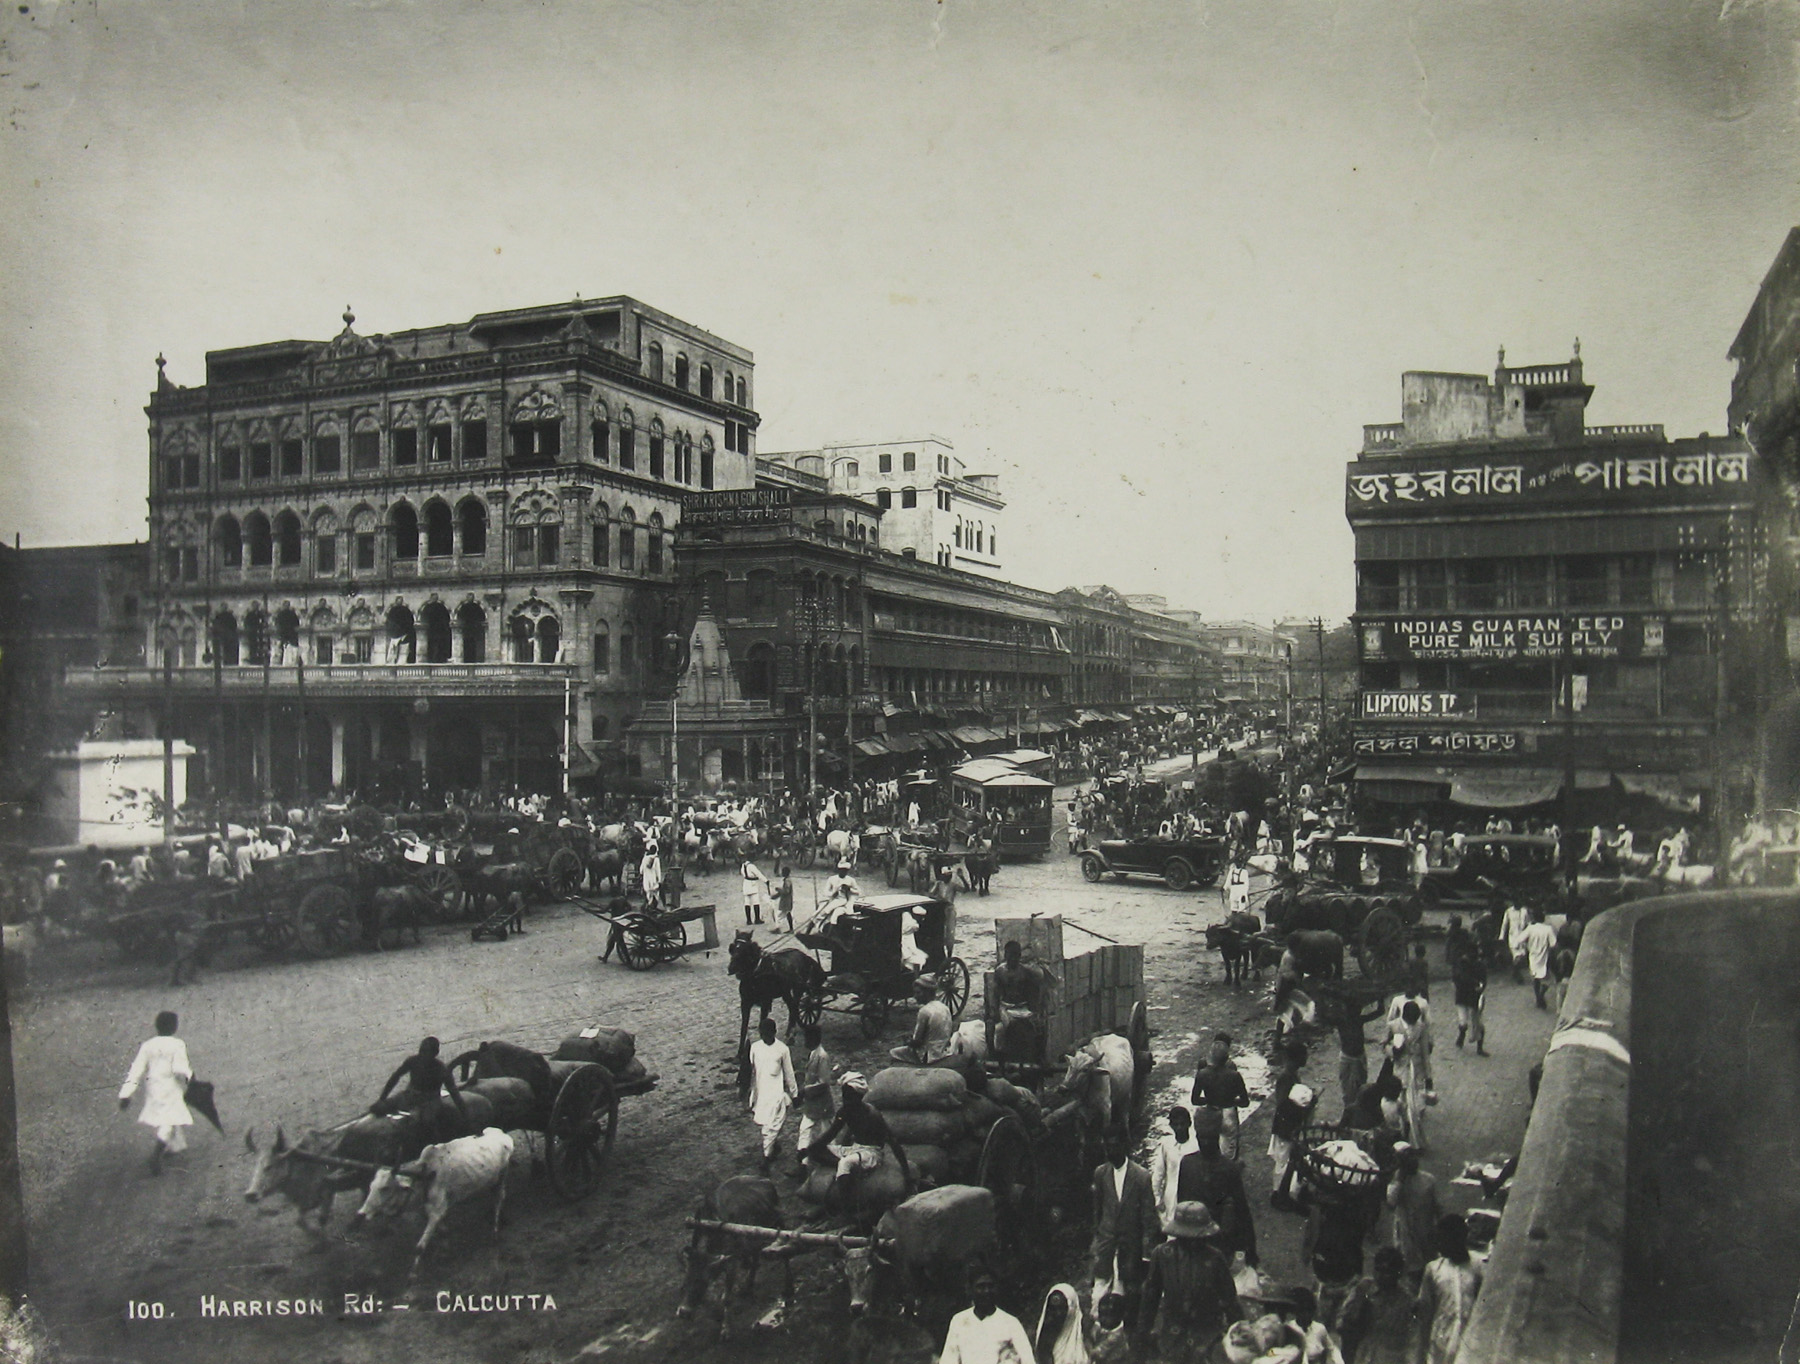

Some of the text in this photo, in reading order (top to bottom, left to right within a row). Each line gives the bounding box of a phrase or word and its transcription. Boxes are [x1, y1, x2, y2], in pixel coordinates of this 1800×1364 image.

[1350, 465, 1524, 503] জহরলাল
[1575, 452, 1749, 490] পান্নালাল
[1394, 620, 1463, 634] INDIA'S
[1472, 616, 1624, 633] GUARANEED
[1409, 634, 1460, 648] PURE
[1469, 632, 1516, 648] MILK
[1366, 694, 1433, 713] LIPTON'S
